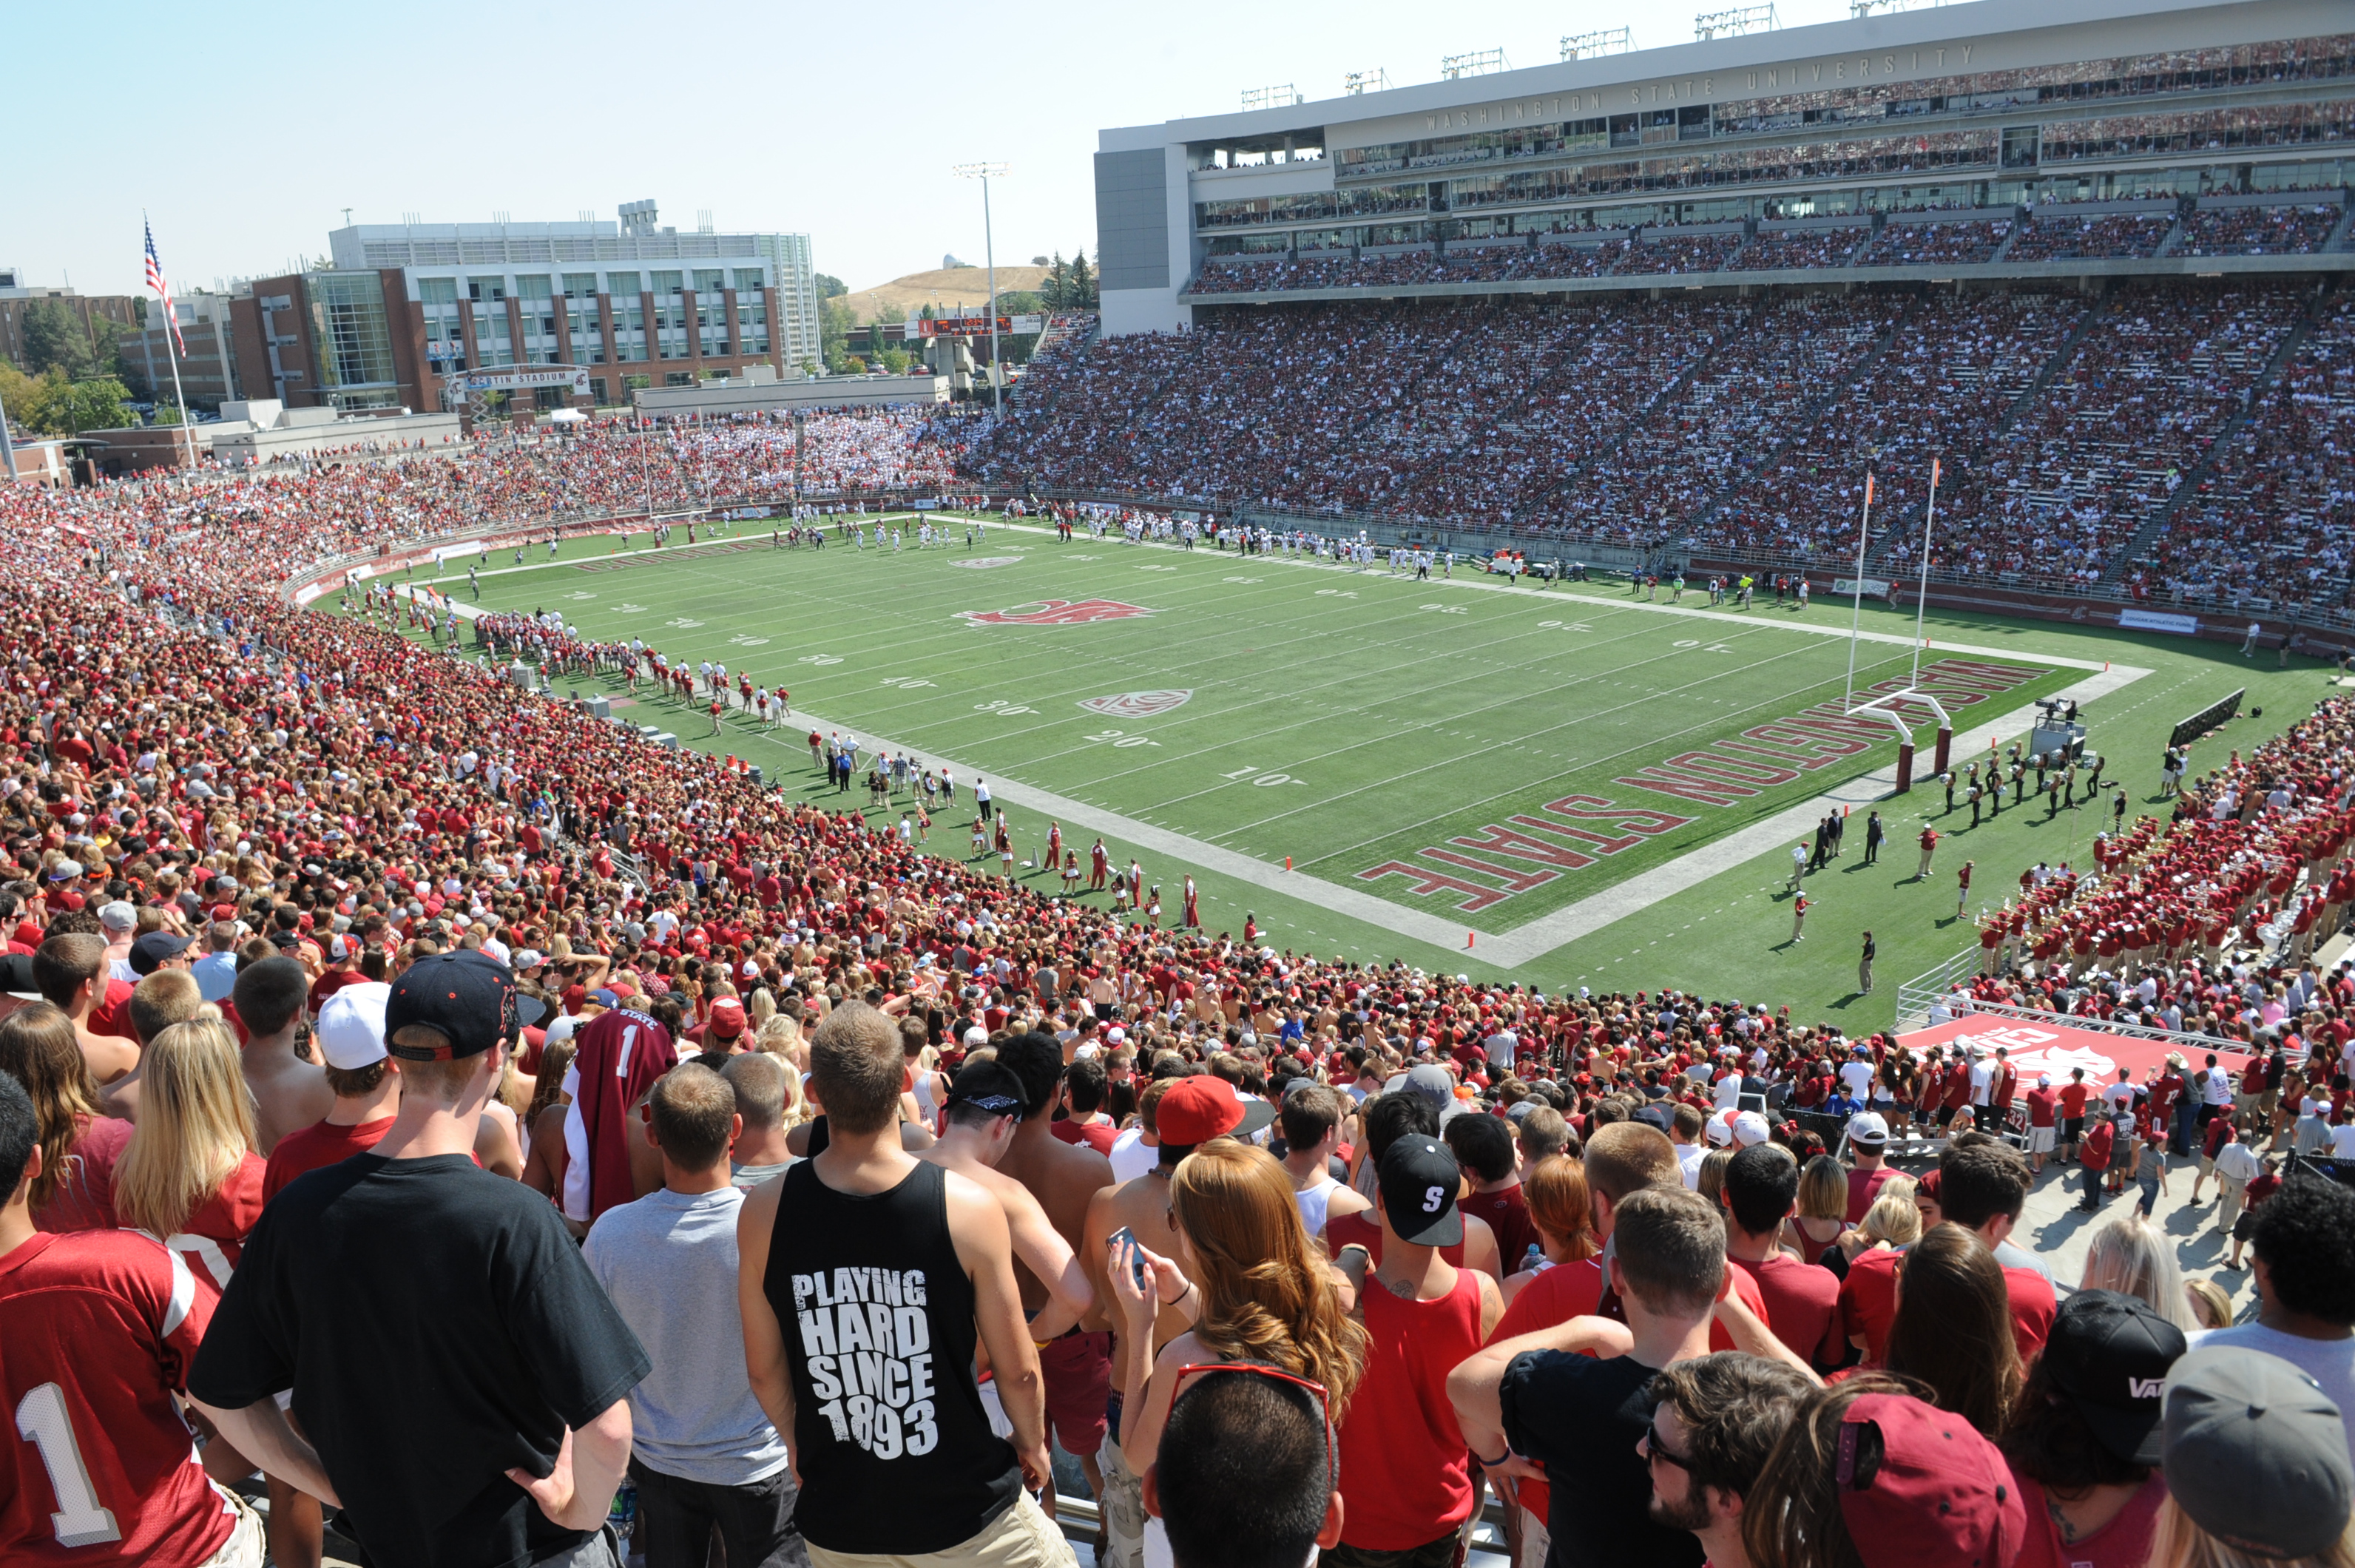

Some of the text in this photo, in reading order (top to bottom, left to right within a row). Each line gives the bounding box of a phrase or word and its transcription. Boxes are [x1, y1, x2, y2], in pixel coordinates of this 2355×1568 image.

[1426, 45, 1973, 132] WASHINGTON STATE UNIVERSITY
[519, 372, 567, 383] STADIUM
[562, 591, 598, 601] 10
[1314, 589, 1359, 598] 40
[1868, 583, 1885, 592] 360
[1419, 604, 1468, 615] 30
[666, 617, 706, 629] 30
[728, 633, 771, 646] 40
[1672, 640, 1732, 652] 10
[797, 653, 845, 666] 50
[879, 676, 930, 689] 40
[973, 700, 1030, 717] 30
[1082, 729, 1149, 748] 20
[1218, 766, 1291, 787] 10
[1353, 658, 2057, 914] WASHINGTON STATE
[619, 1008, 659, 1031] STATE
[615, 1024, 639, 1078] 1
[1934, 1073, 1942, 1087] 3
[2008, 1067, 2016, 1080] 3
[2163, 1089, 2180, 1105] 17
[2007, 1109, 2024, 1131] 32
[1422, 1186, 1445, 1213] S
[791, 1266, 927, 1311] PLAYING
[797, 1302, 930, 1360] HARD
[807, 1350, 936, 1409] SINCE
[817, 1394, 939, 1461] 1893
[15, 1381, 122, 1548] 1
